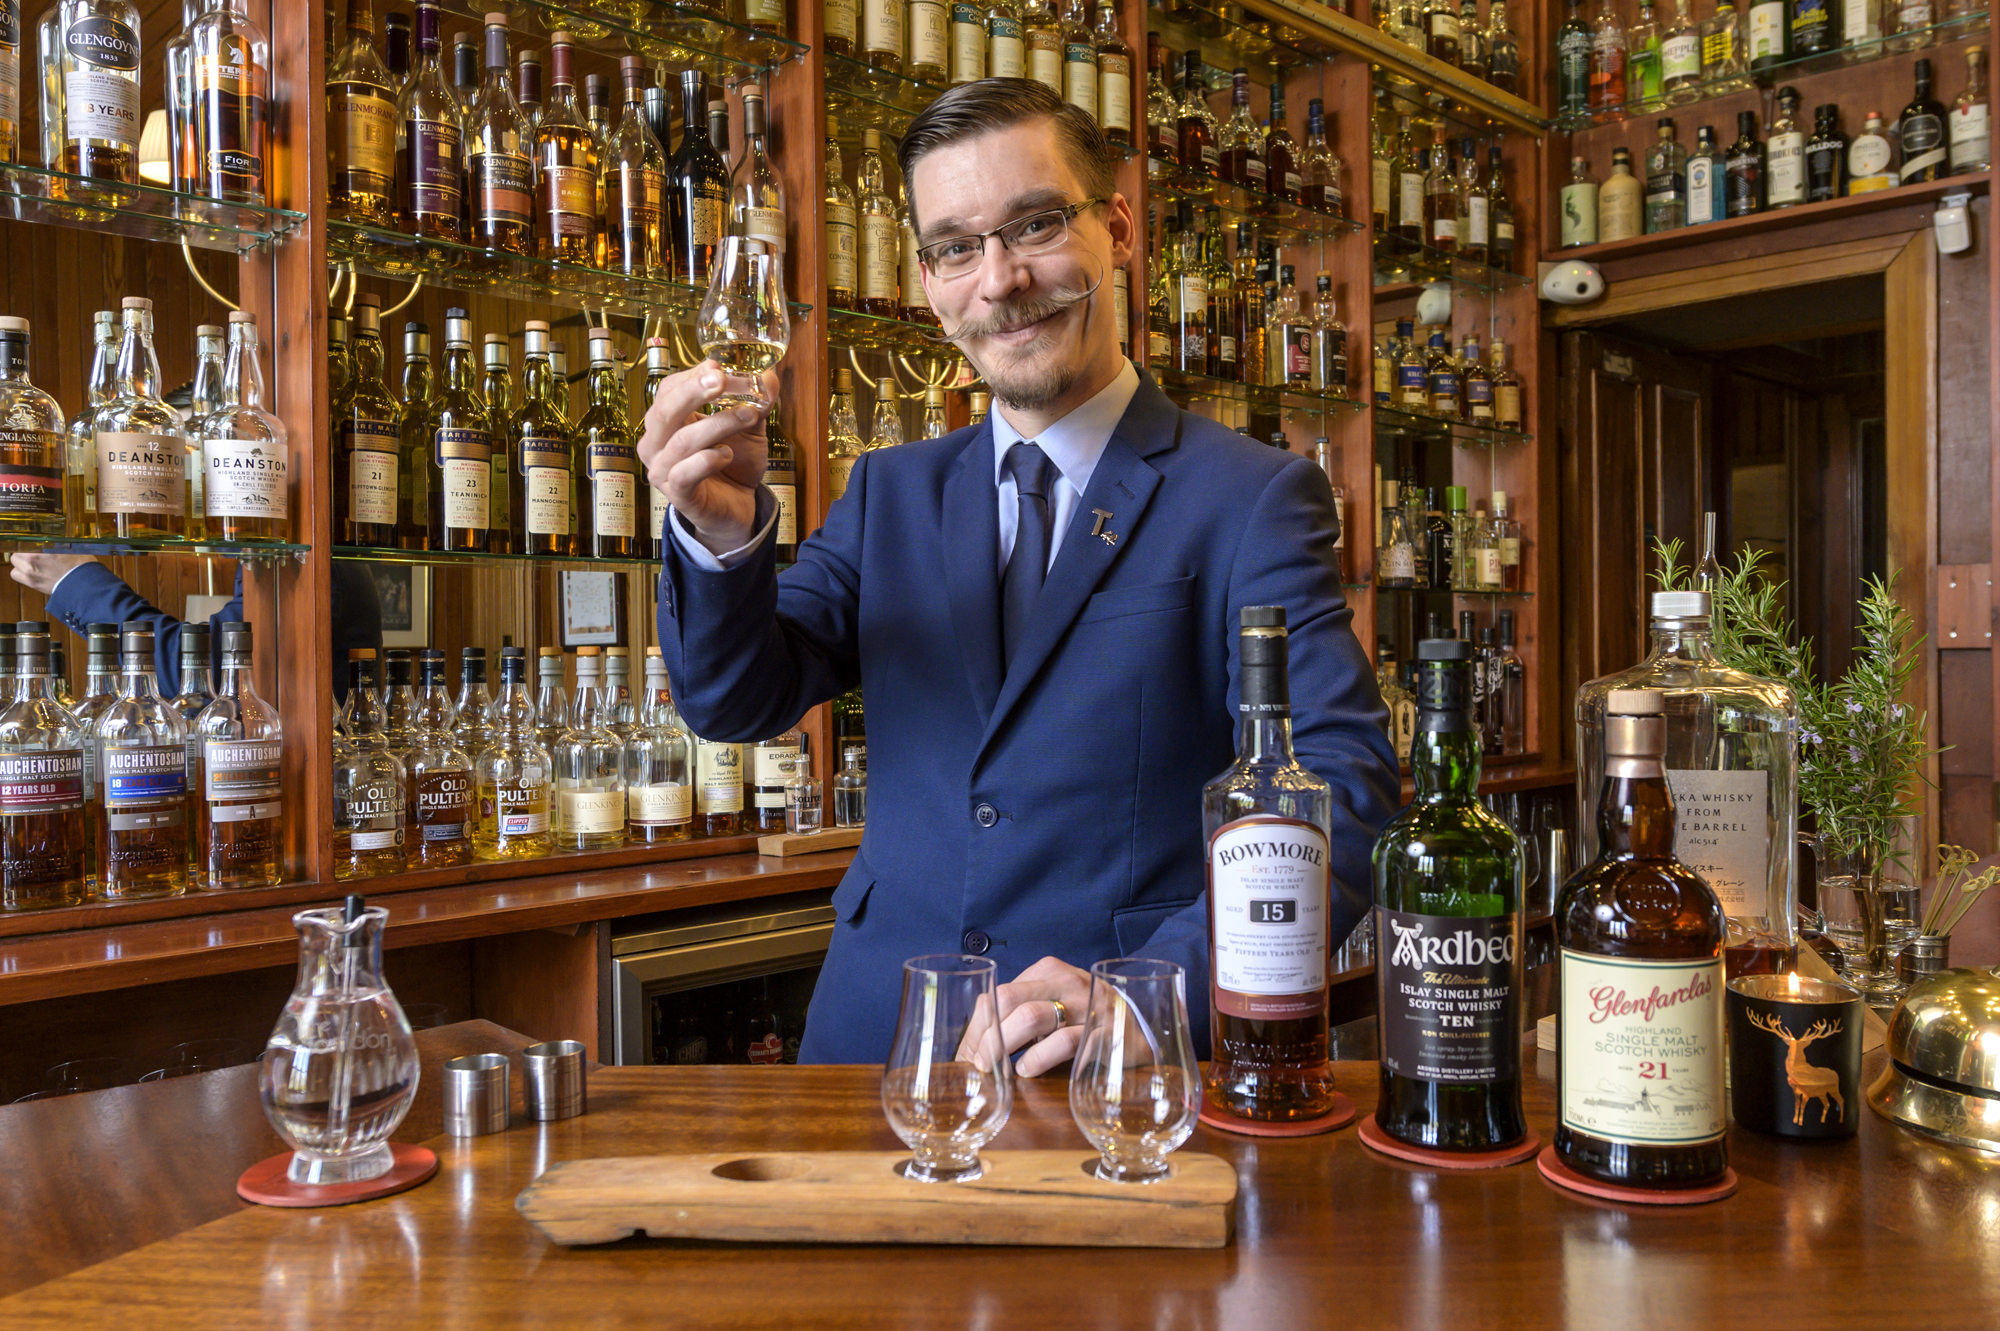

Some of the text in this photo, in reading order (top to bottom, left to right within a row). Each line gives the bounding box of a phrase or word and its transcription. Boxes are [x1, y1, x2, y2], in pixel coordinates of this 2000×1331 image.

[70, 33, 139, 58] GLENGOYNE
[100, 53, 118, 61] 1833
[99, 105, 134, 121] YEARS
[224, 155, 249, 167] FIOR
[148, 442, 159, 452] 12
[109, 452, 184, 466] DEANSTON
[213, 457, 286, 472] DEANSTON
[371, 472, 382, 480] 21
[466, 479, 477, 488] 23
[450, 491, 487, 499] TEANINICH
[615, 490, 624, 498] 22
[109, 752, 185, 768] AUCHENTOSHAN
[211, 746, 280, 762] AUCHENTOSHAN
[0, 757, 81, 775] AUCHENTOSHAN
[223, 772, 246, 781] YEARS
[519, 776, 545, 789] OLD
[112, 779, 122, 788] 18
[122, 778, 146, 787] YEARS
[440, 779, 467, 792] OLD
[1, 784, 56, 795] 12 YEARS OLD
[367, 787, 397, 800] OLD
[1702, 793, 1754, 802] WHISKY
[1687, 808, 1721, 816] FROM
[1694, 823, 1747, 832] BARREL
[1689, 837, 1702, 845] alc
[1218, 842, 1324, 867] BOWMORE
[1274, 865, 1294, 874] 1779
[1226, 903, 1320, 921] AGED 15 YEARS
[1235, 948, 1310, 957] FIFTEEN YEARS OLD
[1422, 971, 1490, 985] The Ultimate
[1400, 983, 1509, 999] ISLAY SINGLE MALT
[1589, 972, 1712, 1024] Glenfarclas
[1408, 998, 1502, 1012] SCOTCH WHISKY
[1439, 1015, 1475, 1027] TEN
[1422, 1030, 1490, 1039] NON CHILL-FILTERED
[1625, 1026, 1682, 1035] HIGHLAND
[1606, 1032, 1699, 1046] SINGLE MALT
[1595, 1041, 1707, 1058] SCOTCH WHISKY
[1417, 1064, 1496, 1074] ARDBEG DISTILLERY LIMITED
[1639, 1061, 1672, 1080] 21
